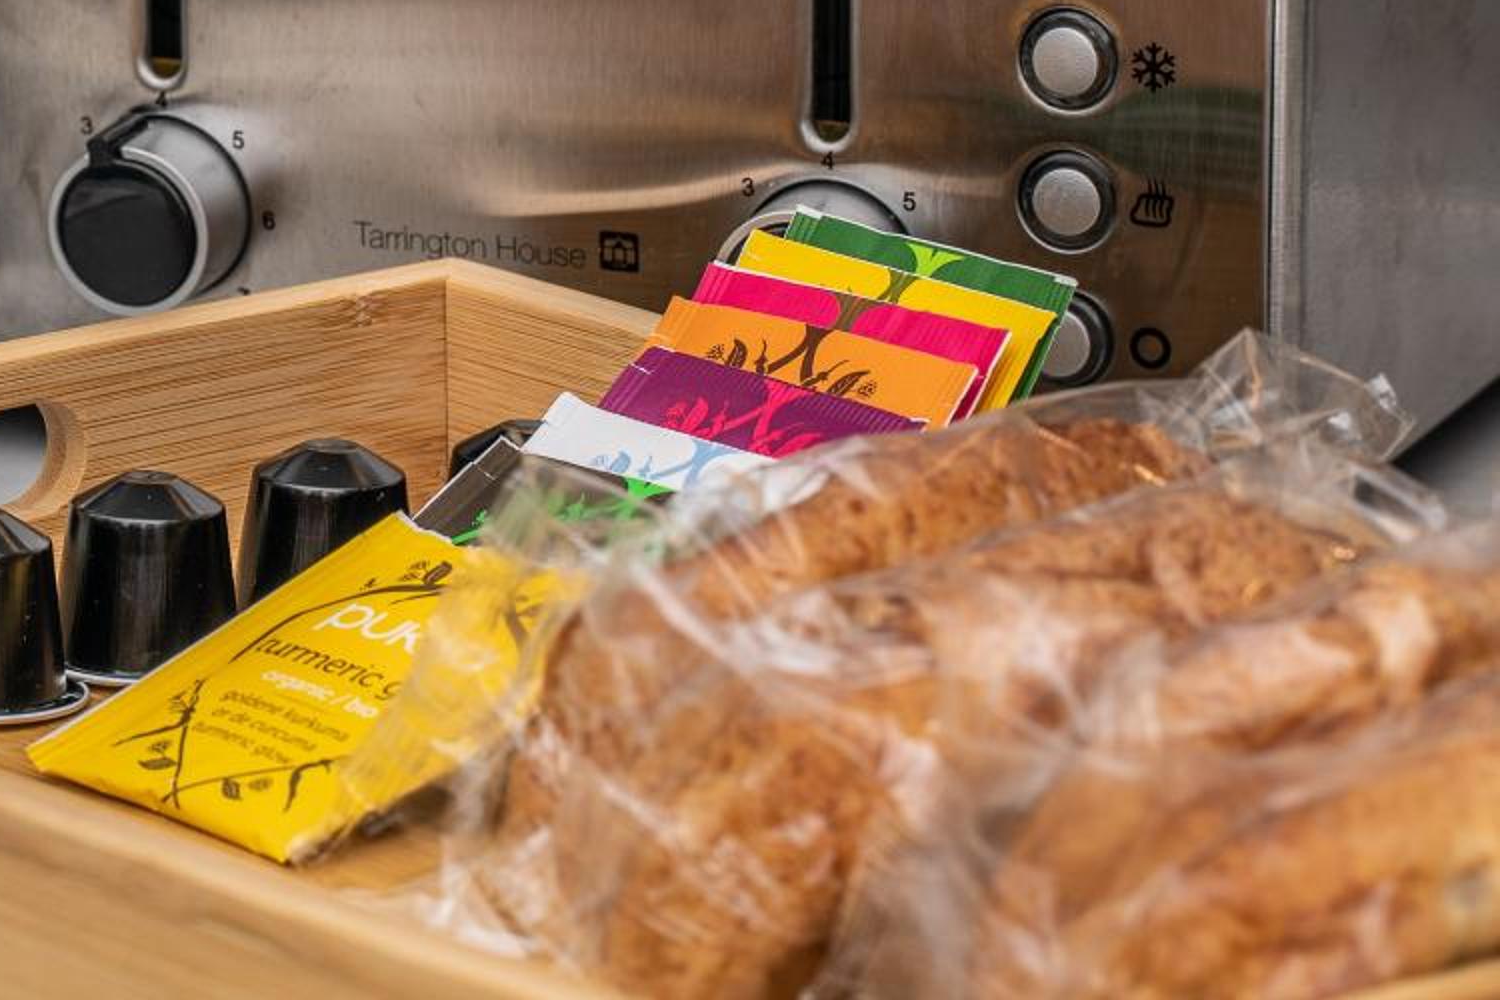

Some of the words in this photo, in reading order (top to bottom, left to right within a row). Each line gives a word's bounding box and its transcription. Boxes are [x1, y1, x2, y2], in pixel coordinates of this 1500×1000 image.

[80, 116, 93, 135] 3
[232, 131, 245, 149] 5
[820, 152, 834, 170] 4
[741, 178, 755, 197] 3
[902, 192, 916, 211] 5
[262, 211, 276, 231] 6
[353, 220, 487, 260] Tarrington
[495, 235, 588, 269] House
[256, 637, 384, 688] turmeric
